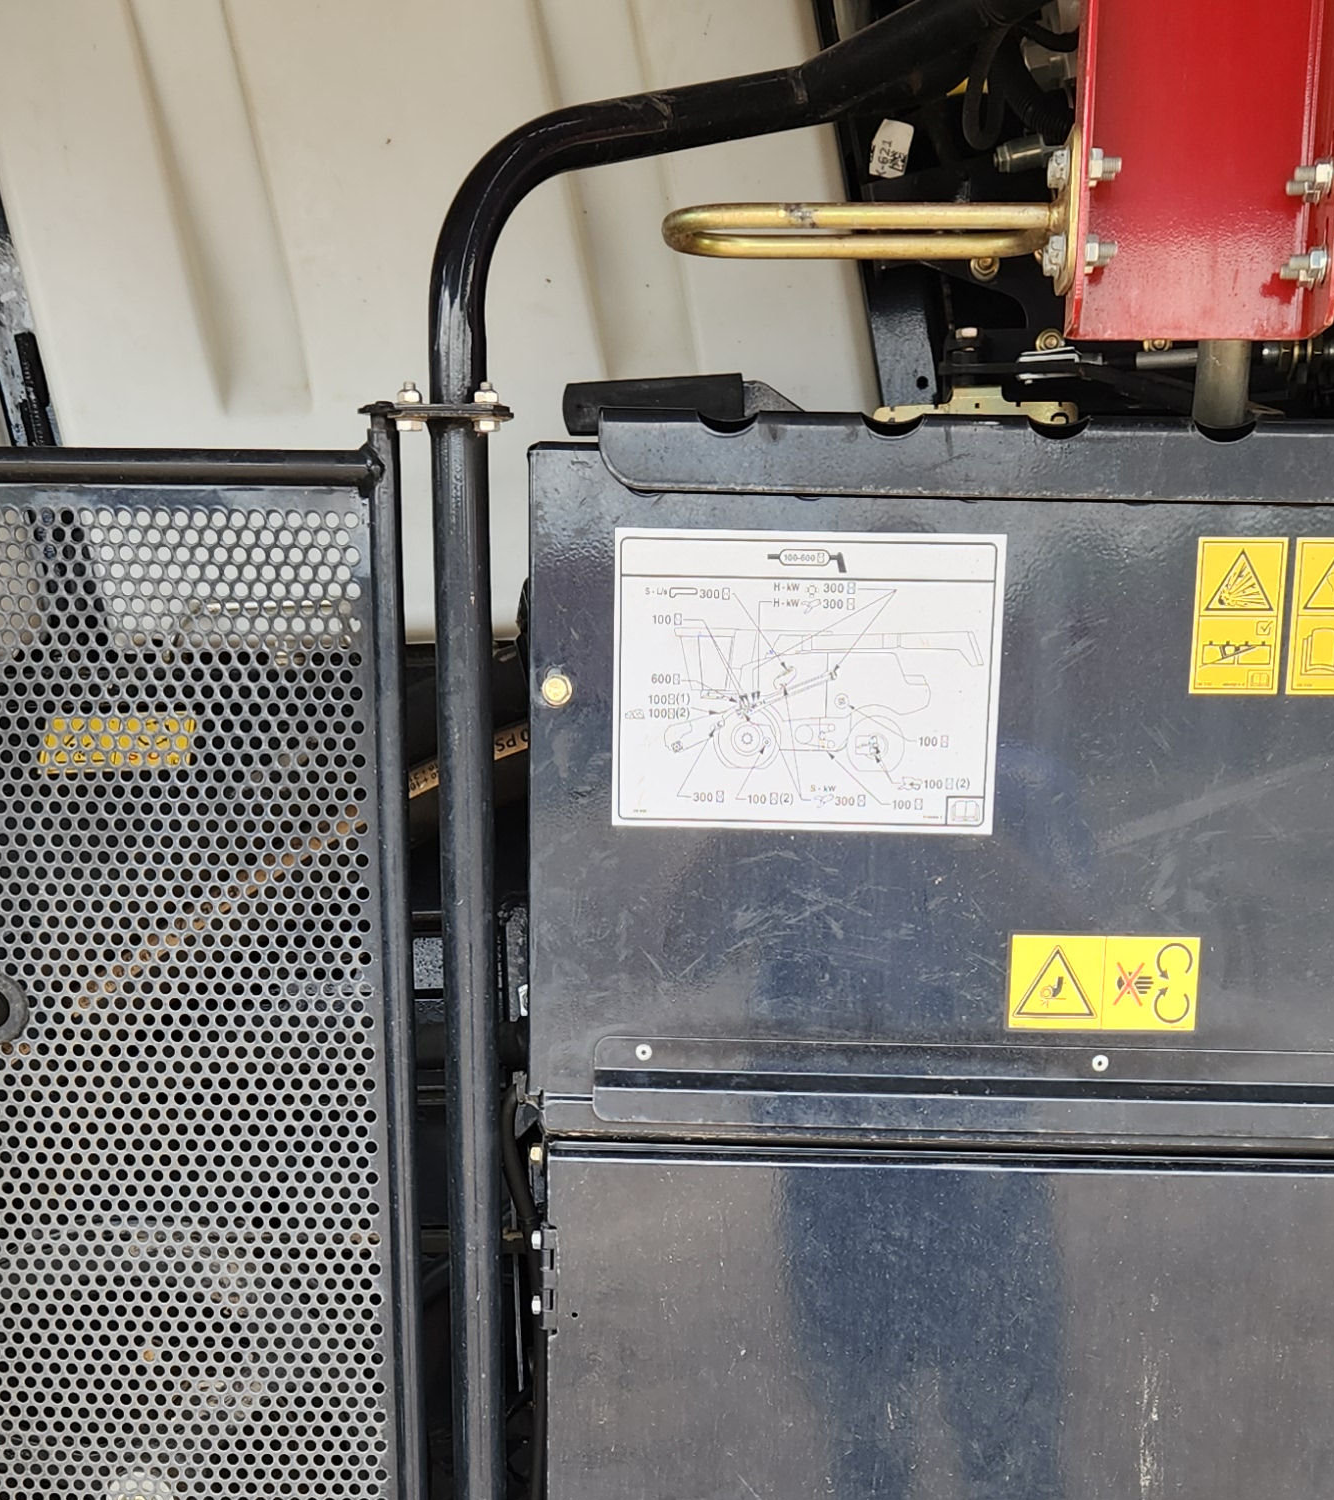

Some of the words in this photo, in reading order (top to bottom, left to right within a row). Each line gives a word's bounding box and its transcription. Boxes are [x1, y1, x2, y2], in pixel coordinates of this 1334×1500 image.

[823, 583, 845, 593] 300
[699, 589, 720, 599] 300
[822, 599, 844, 609] 300
[652, 615, 672, 625] 100
[651, 673, 672, 684] 600
[648, 694, 667, 705] 100
[676, 693, 691, 706] (1)
[648, 708, 667, 719] 100
[676, 707, 691, 720] (2)
[919, 736, 938, 747] 100
[924, 779, 943, 790] 100
[955, 777, 971, 791] (2)
[693, 792, 714, 803] 300
[747, 795, 767, 805] 100
[780, 793, 794, 806] (2)
[834, 796, 855, 807] 300
[893, 799, 912, 810] 100
